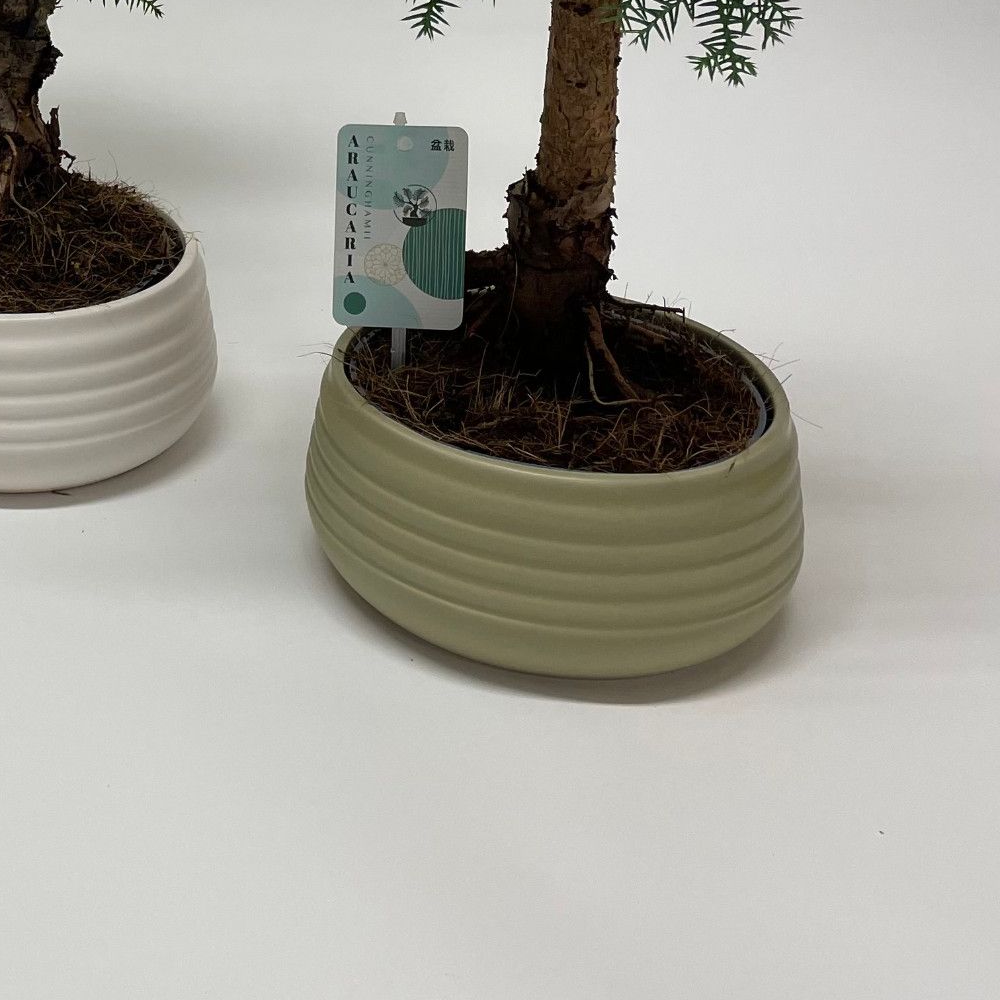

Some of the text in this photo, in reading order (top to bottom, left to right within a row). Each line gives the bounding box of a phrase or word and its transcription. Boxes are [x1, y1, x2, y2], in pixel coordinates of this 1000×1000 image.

[363, 135, 375, 240] CUNNINGHAMII
[430, 139, 455, 152] 盆栽
[343, 134, 359, 284] ARAUCARIA
